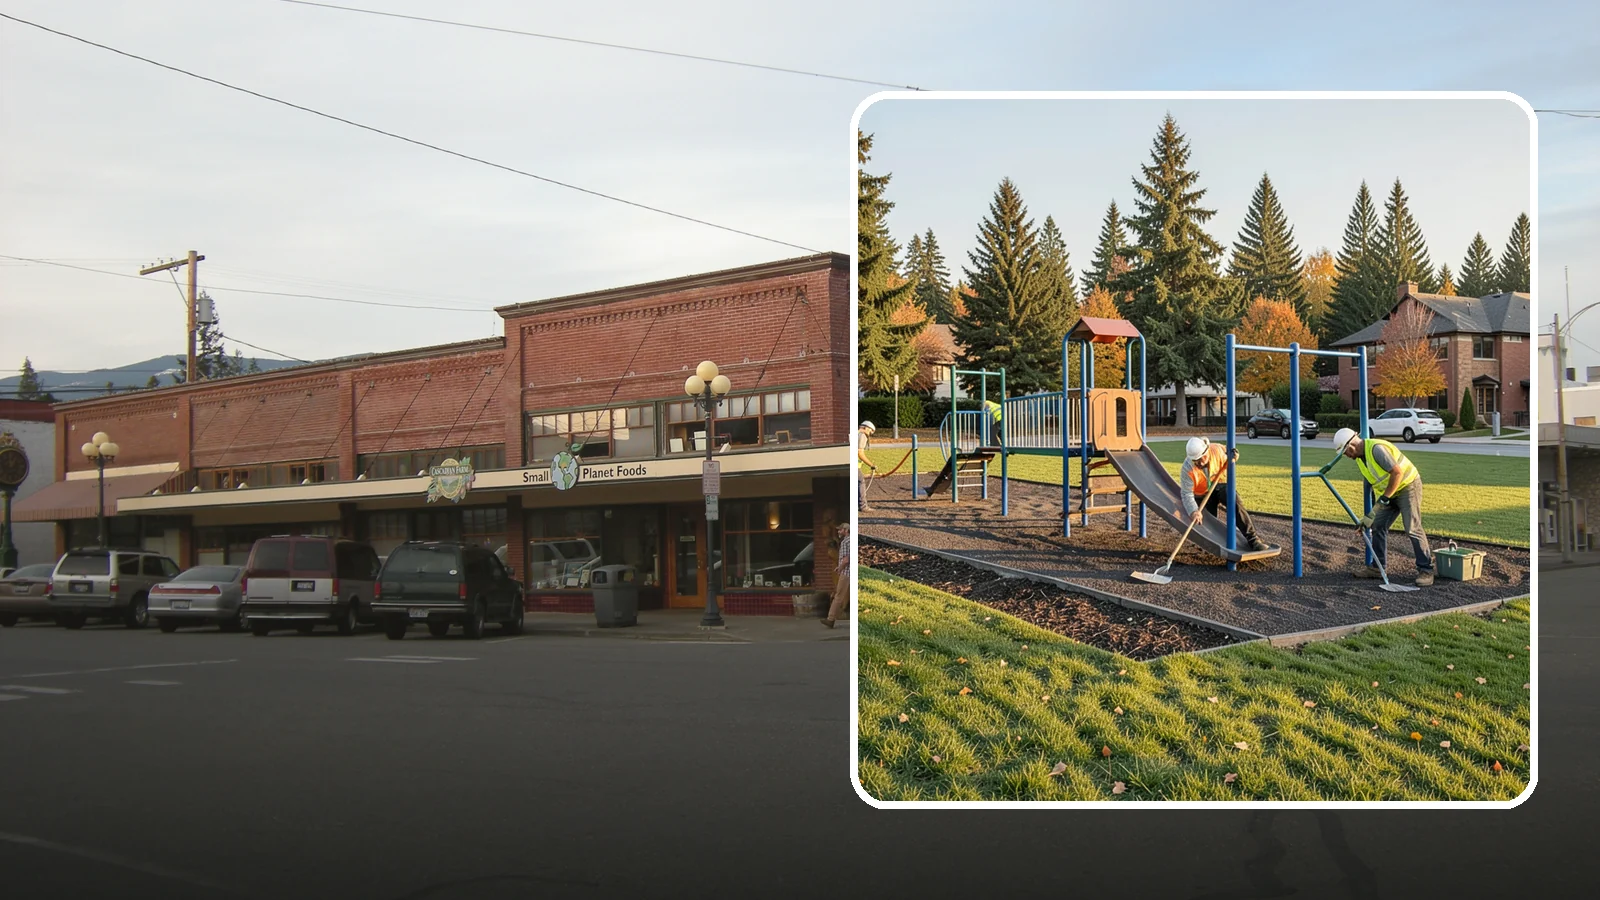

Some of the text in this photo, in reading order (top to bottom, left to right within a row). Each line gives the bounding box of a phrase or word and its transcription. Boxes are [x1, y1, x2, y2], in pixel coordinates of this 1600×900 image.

[523, 464, 647, 483] Small Planet Foods
